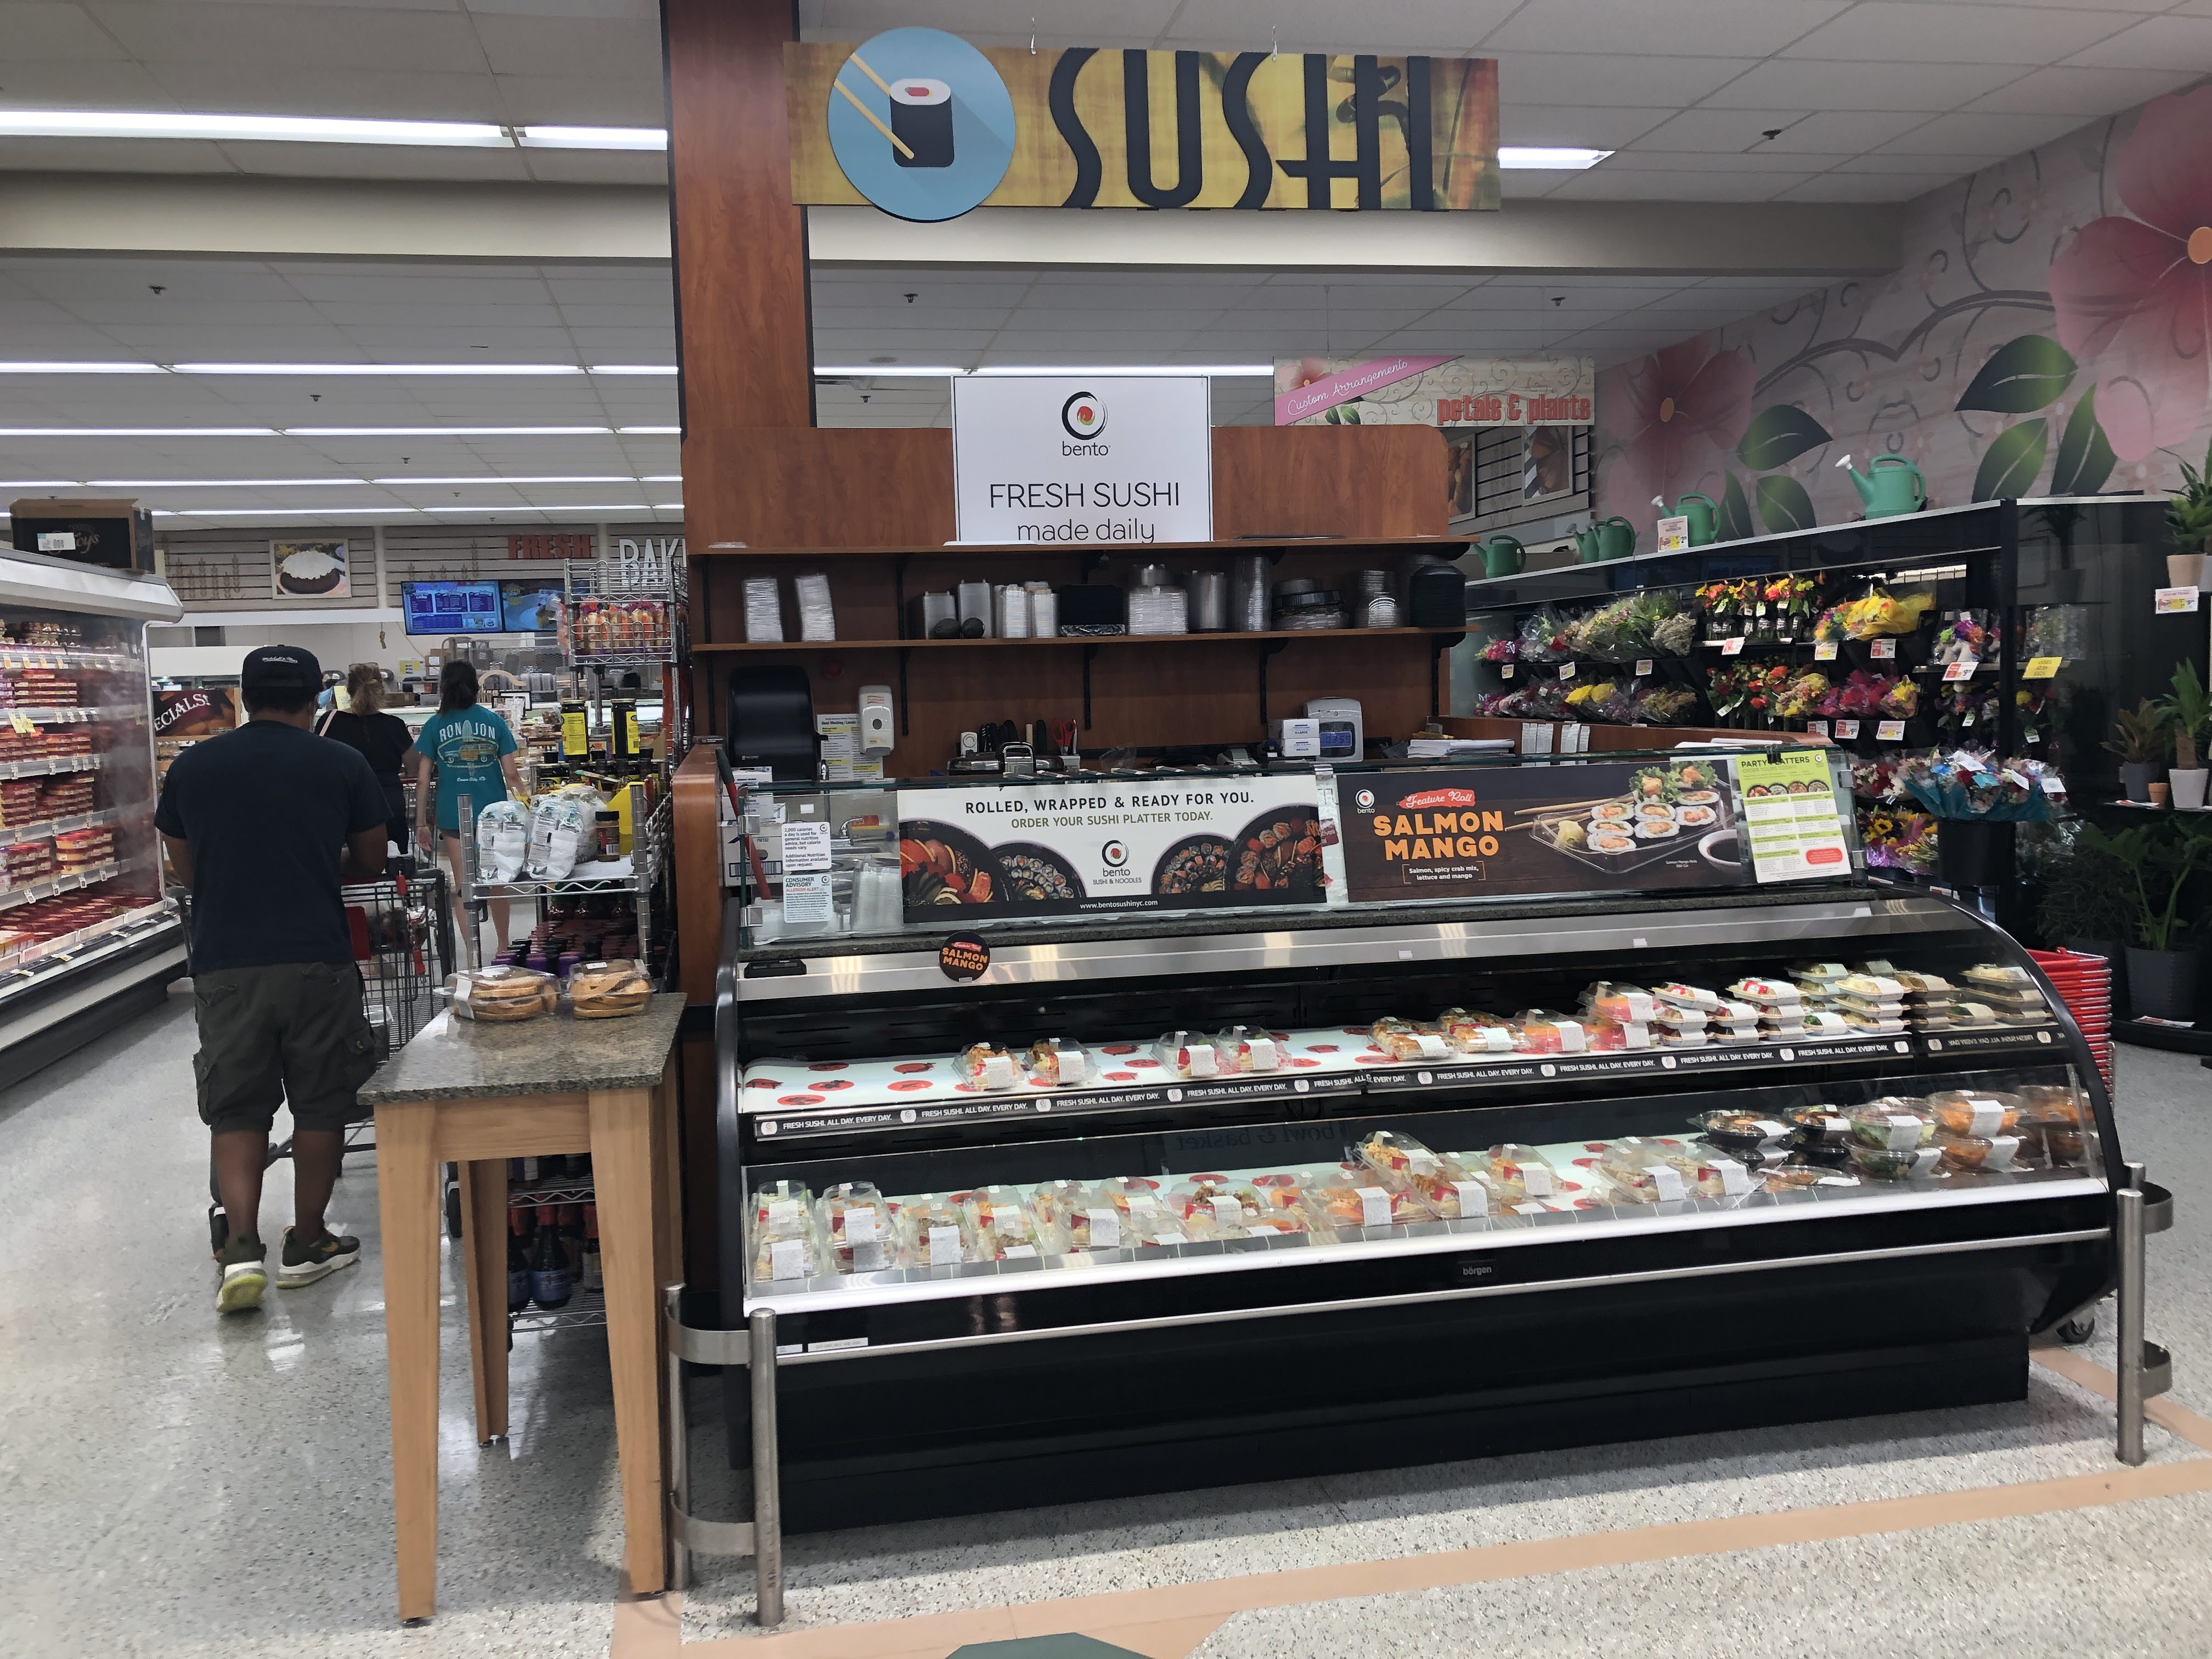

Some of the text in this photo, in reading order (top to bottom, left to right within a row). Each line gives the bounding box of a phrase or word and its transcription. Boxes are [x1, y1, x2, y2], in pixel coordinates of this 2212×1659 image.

[1048, 47, 1431, 210] SUSHI
[1288, 359, 1408, 415] Custom Arrangements
[1437, 394, 1590, 425] petals & plants
[1062, 441, 1110, 456] bento
[990, 482, 1179, 508] FRESH SUSHI
[1018, 518, 1154, 544] made daily
[507, 534, 591, 559] FRESH
[439, 722, 495, 742] RON JON
[1741, 756, 1810, 768] PARTY ATTERS
[965, 792, 1254, 814] ROLLED, WRAPPED & READY FOR YOU.
[1406, 791, 1472, 808] Feature Roll
[1011, 811, 1214, 829] ORDER YOUR SUSHI PLATTER TODAY.
[1373, 810, 1504, 837] SALMON
[1384, 835, 1499, 861] MANGO
[1103, 867, 1131, 877] bento
[1080, 900, 1158, 909] www.bentosushinyc.com
[942, 947, 988, 963] SALMON
[943, 956, 984, 970] MANGO
[1858, 1045, 1877, 1053] EVERY
[1354, 1075, 1367, 1084] ALL
[1125, 1093, 1146, 1102] EVERY
[992, 1103, 1013, 1111] EVERY
[783, 1121, 804, 1130] FRESH
[855, 1115, 877, 1124] EVERY
